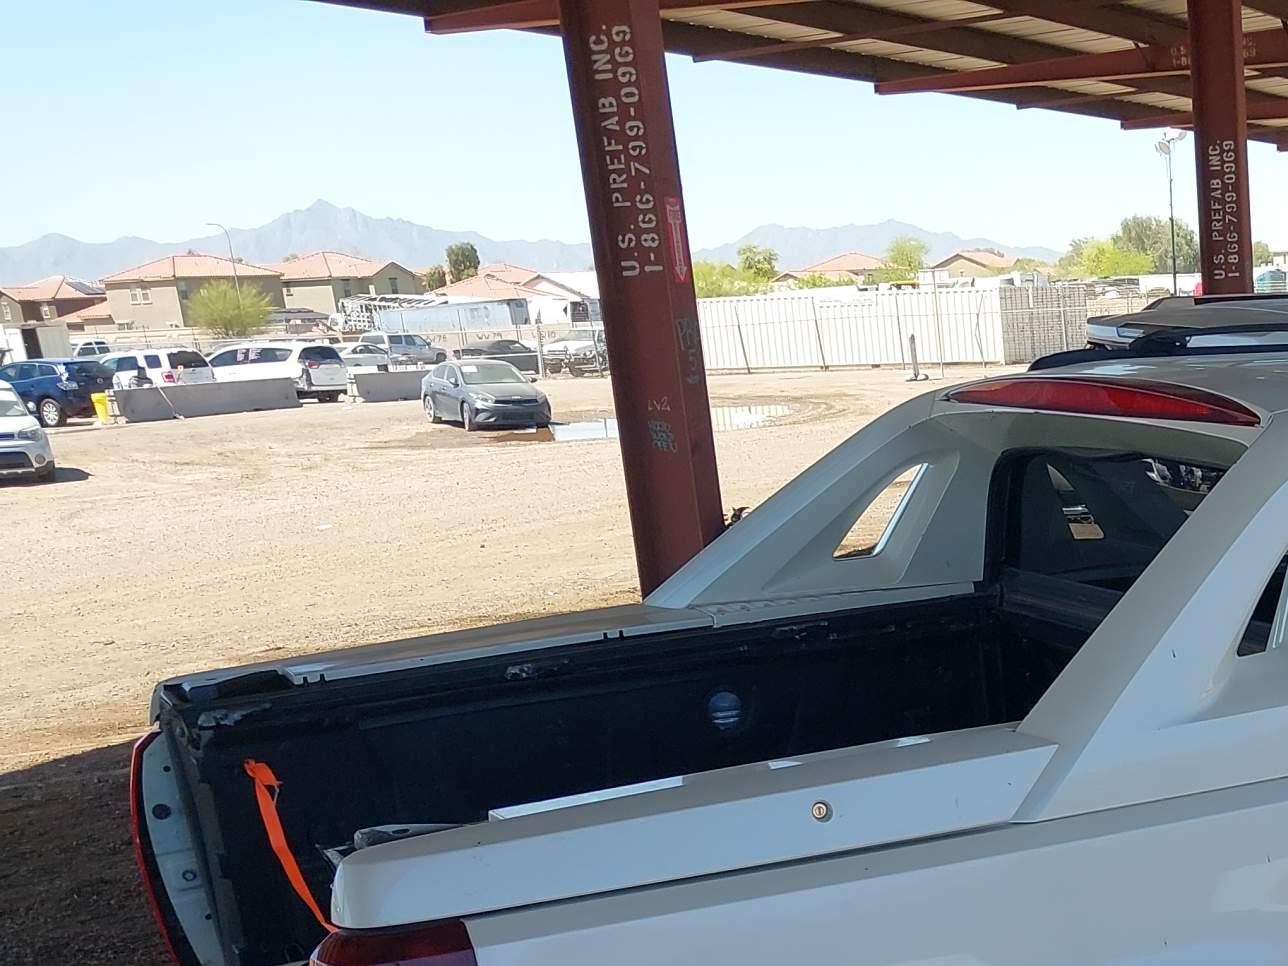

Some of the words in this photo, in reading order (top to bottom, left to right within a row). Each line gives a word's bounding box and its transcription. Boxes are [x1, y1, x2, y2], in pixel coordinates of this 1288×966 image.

[589, 24, 614, 81] INC.
[598, 96, 632, 208] PREFAB
[611, 25, 663, 274] 1-866-799-0969
[1208, 140, 1221, 171] INC.
[1210, 179, 1224, 241] PREFAB
[1223, 140, 1240, 278] 1-866-799-0969
[618, 224, 641, 277] U.S.
[1213, 250, 1226, 280] U.S.
